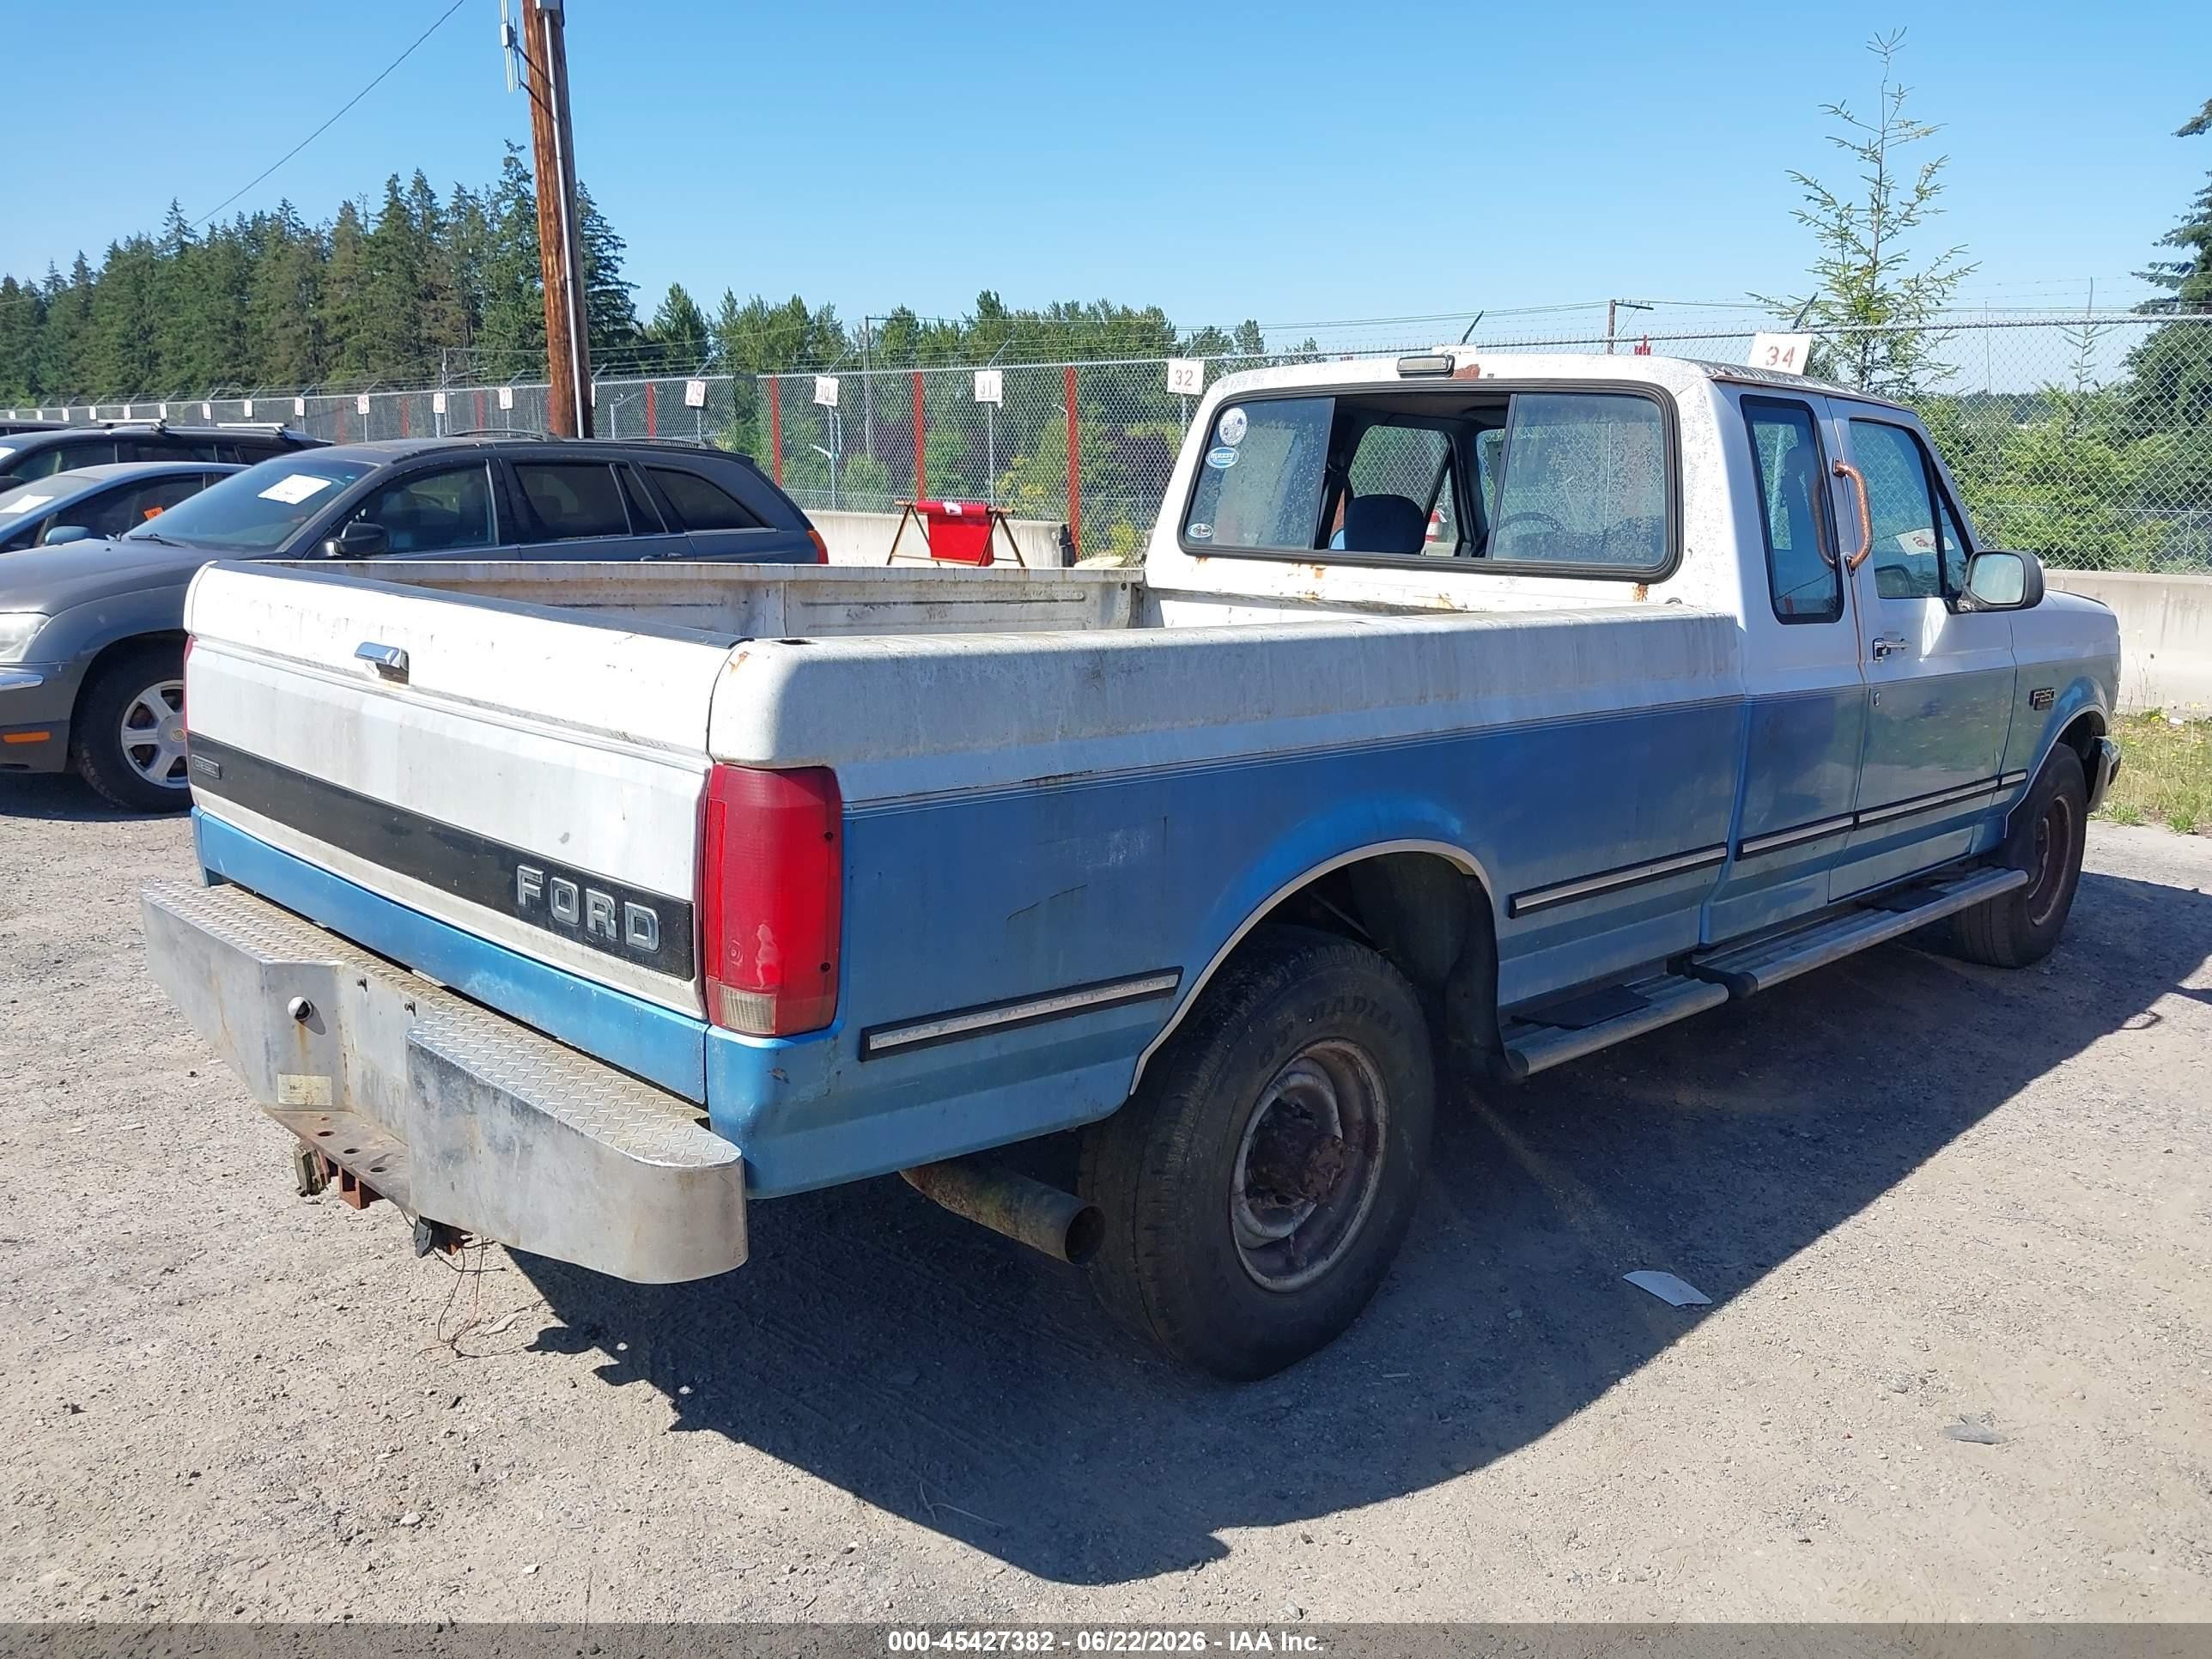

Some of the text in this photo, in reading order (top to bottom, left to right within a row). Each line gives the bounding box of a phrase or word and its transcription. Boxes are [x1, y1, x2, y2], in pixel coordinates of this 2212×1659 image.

[1765, 346, 1796, 368] 34
[1176, 369, 1194, 386] 32
[689, 383, 702, 404] 29
[818, 385, 830, 400] 30
[980, 380, 993, 397] 31
[359, 397, 368, 413] 25
[517, 865, 660, 952] FORD
